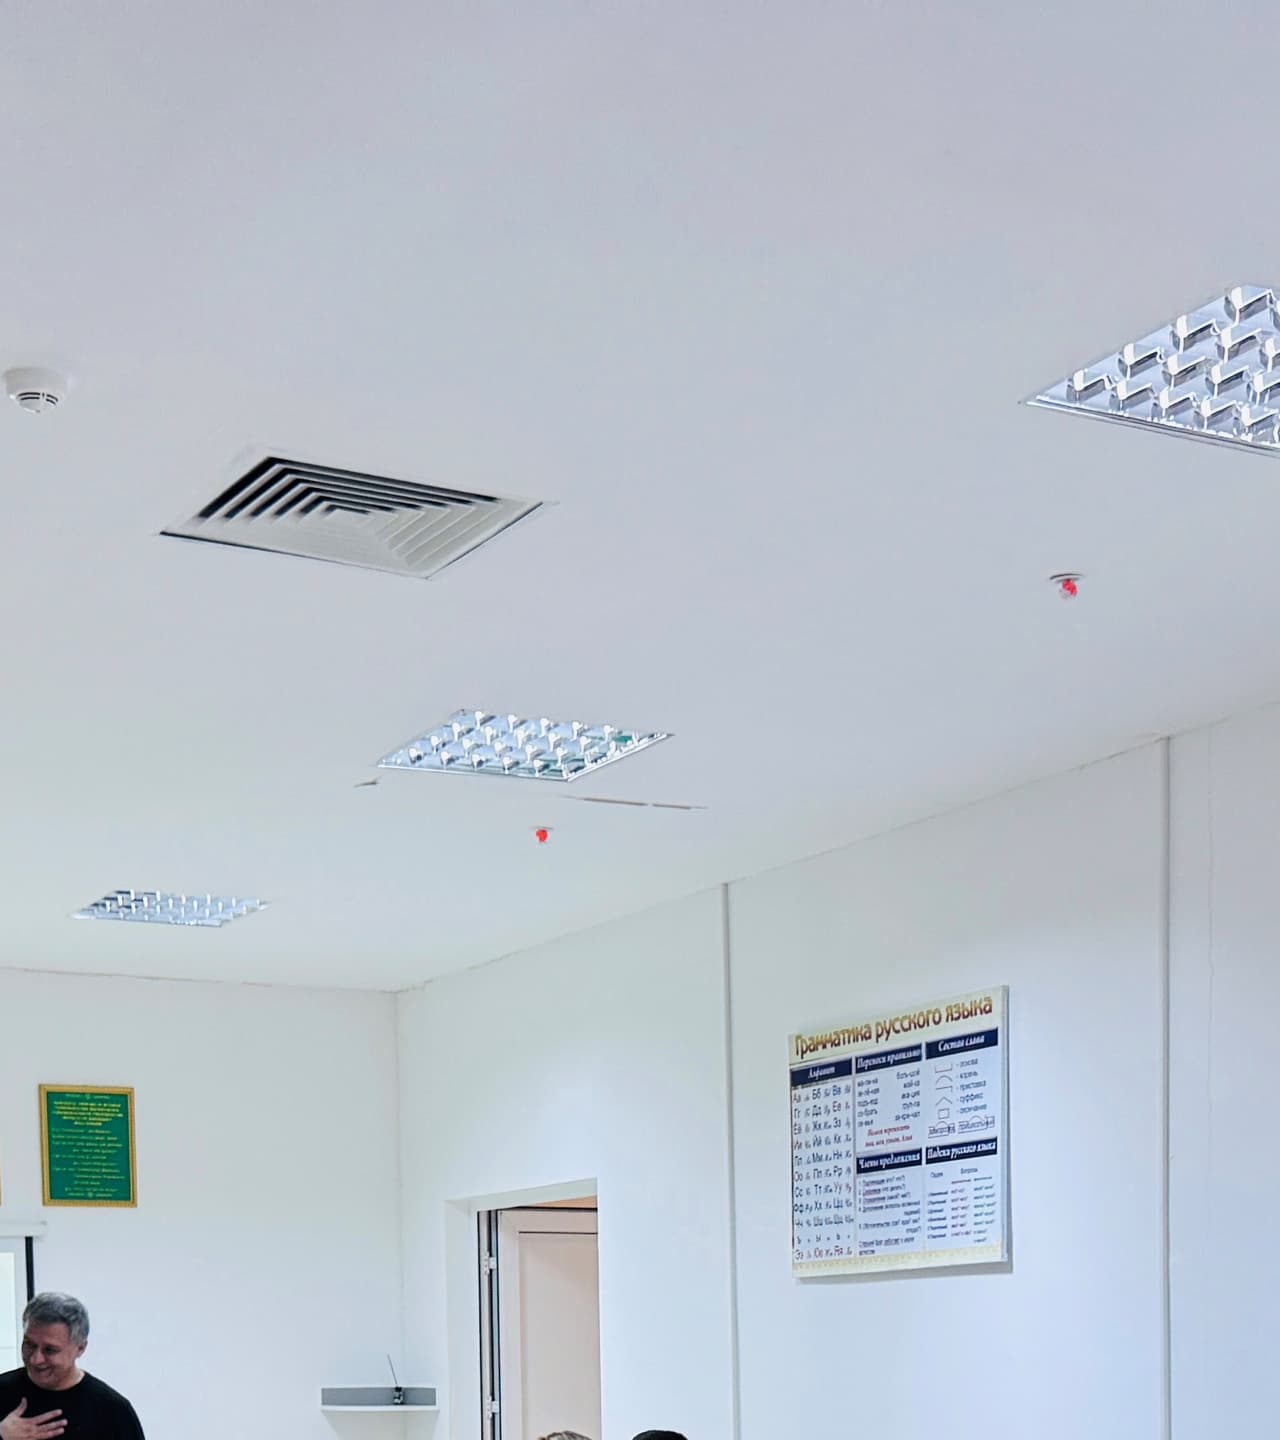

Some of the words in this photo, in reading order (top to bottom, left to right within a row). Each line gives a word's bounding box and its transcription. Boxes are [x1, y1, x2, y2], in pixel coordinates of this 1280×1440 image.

[795, 1023, 871, 1059] Грамматика
[875, 1007, 942, 1043] русского
[945, 996, 993, 1023] языка
